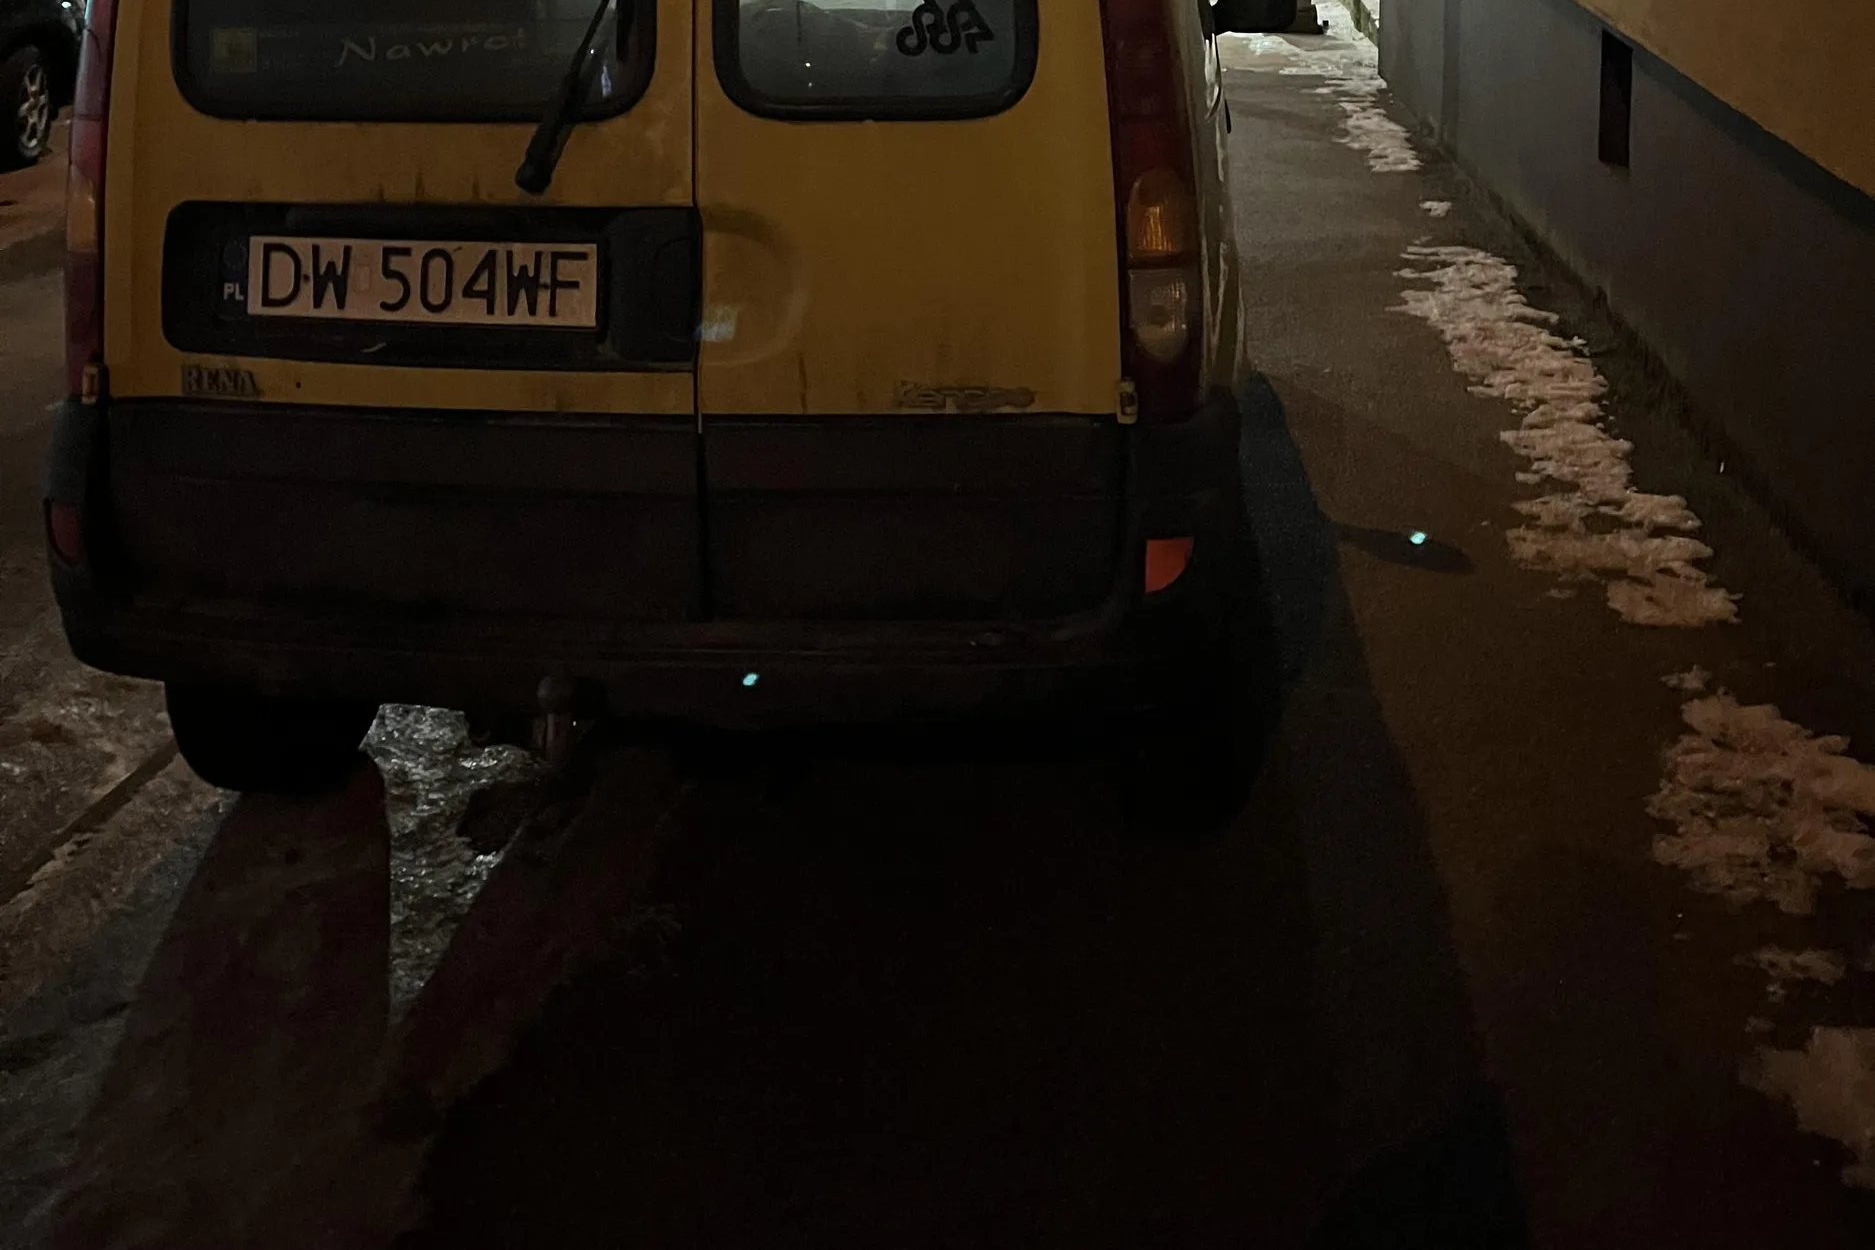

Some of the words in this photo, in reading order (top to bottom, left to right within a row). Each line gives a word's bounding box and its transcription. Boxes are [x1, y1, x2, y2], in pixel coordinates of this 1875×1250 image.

[223, 281, 245, 301] PL
[261, 242, 352, 310] DW
[380, 246, 588, 317] 504WF
